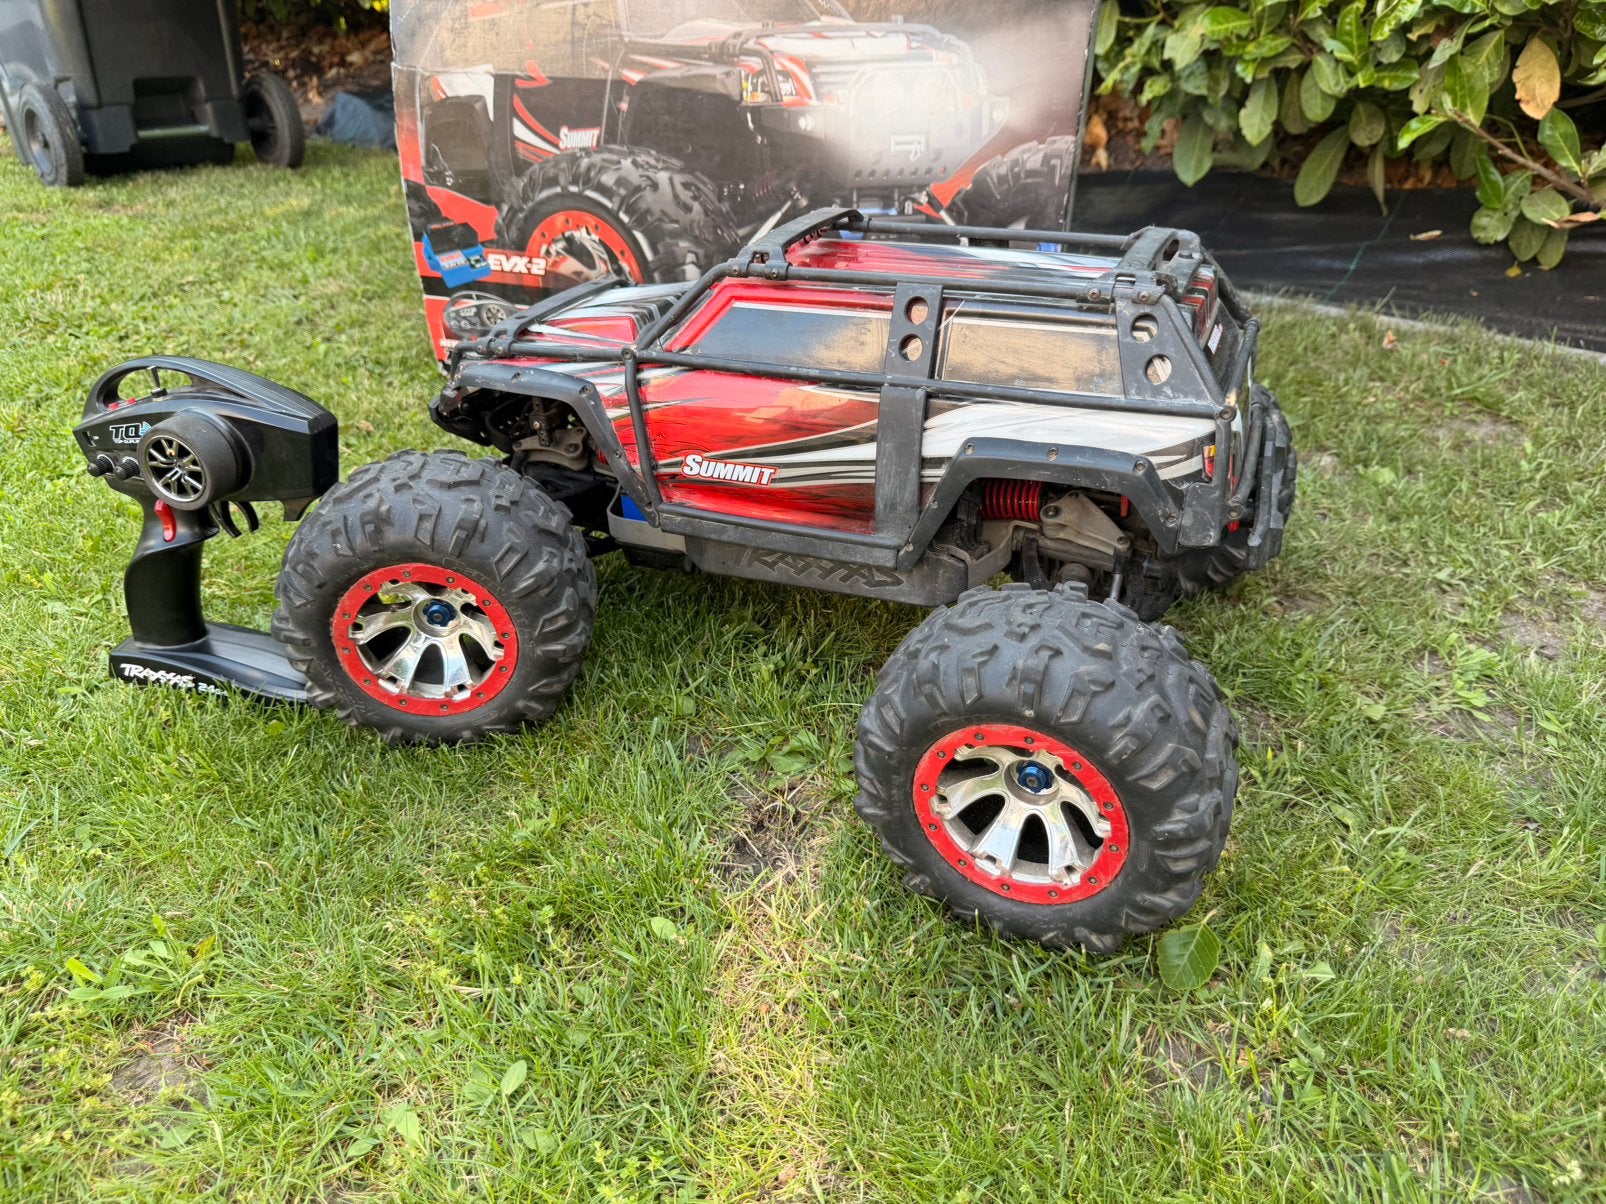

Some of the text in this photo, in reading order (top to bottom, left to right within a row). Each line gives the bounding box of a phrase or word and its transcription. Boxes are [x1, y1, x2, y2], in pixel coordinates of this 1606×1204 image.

[559, 125, 600, 150] SUMMIT
[487, 252, 548, 276] EVX-2
[682, 453, 777, 486] SUMMIT
[120, 663, 196, 688] TRAXXAS
